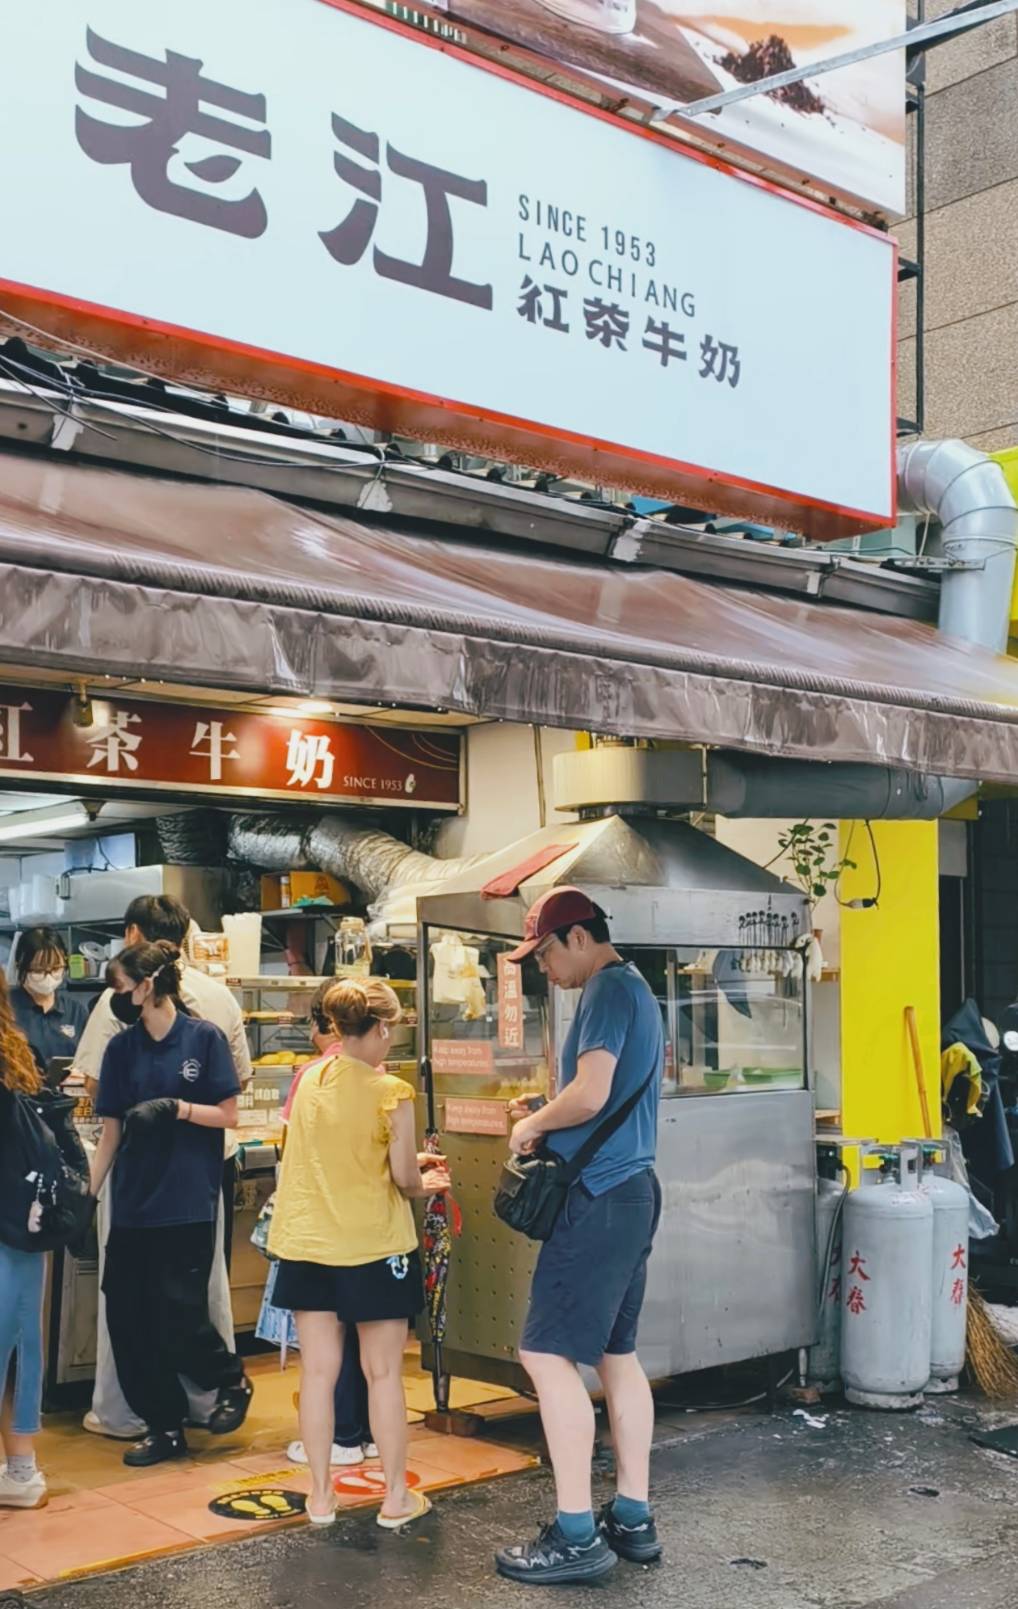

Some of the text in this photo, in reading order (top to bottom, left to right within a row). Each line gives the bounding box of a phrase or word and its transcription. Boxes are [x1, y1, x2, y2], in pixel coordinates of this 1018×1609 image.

[74, 25, 493, 312] 老江
[518, 194, 656, 268] SINCE 1953
[516, 273, 741, 389] 紅茶牛奶
[343, 775, 403, 792] SINCE 1953
